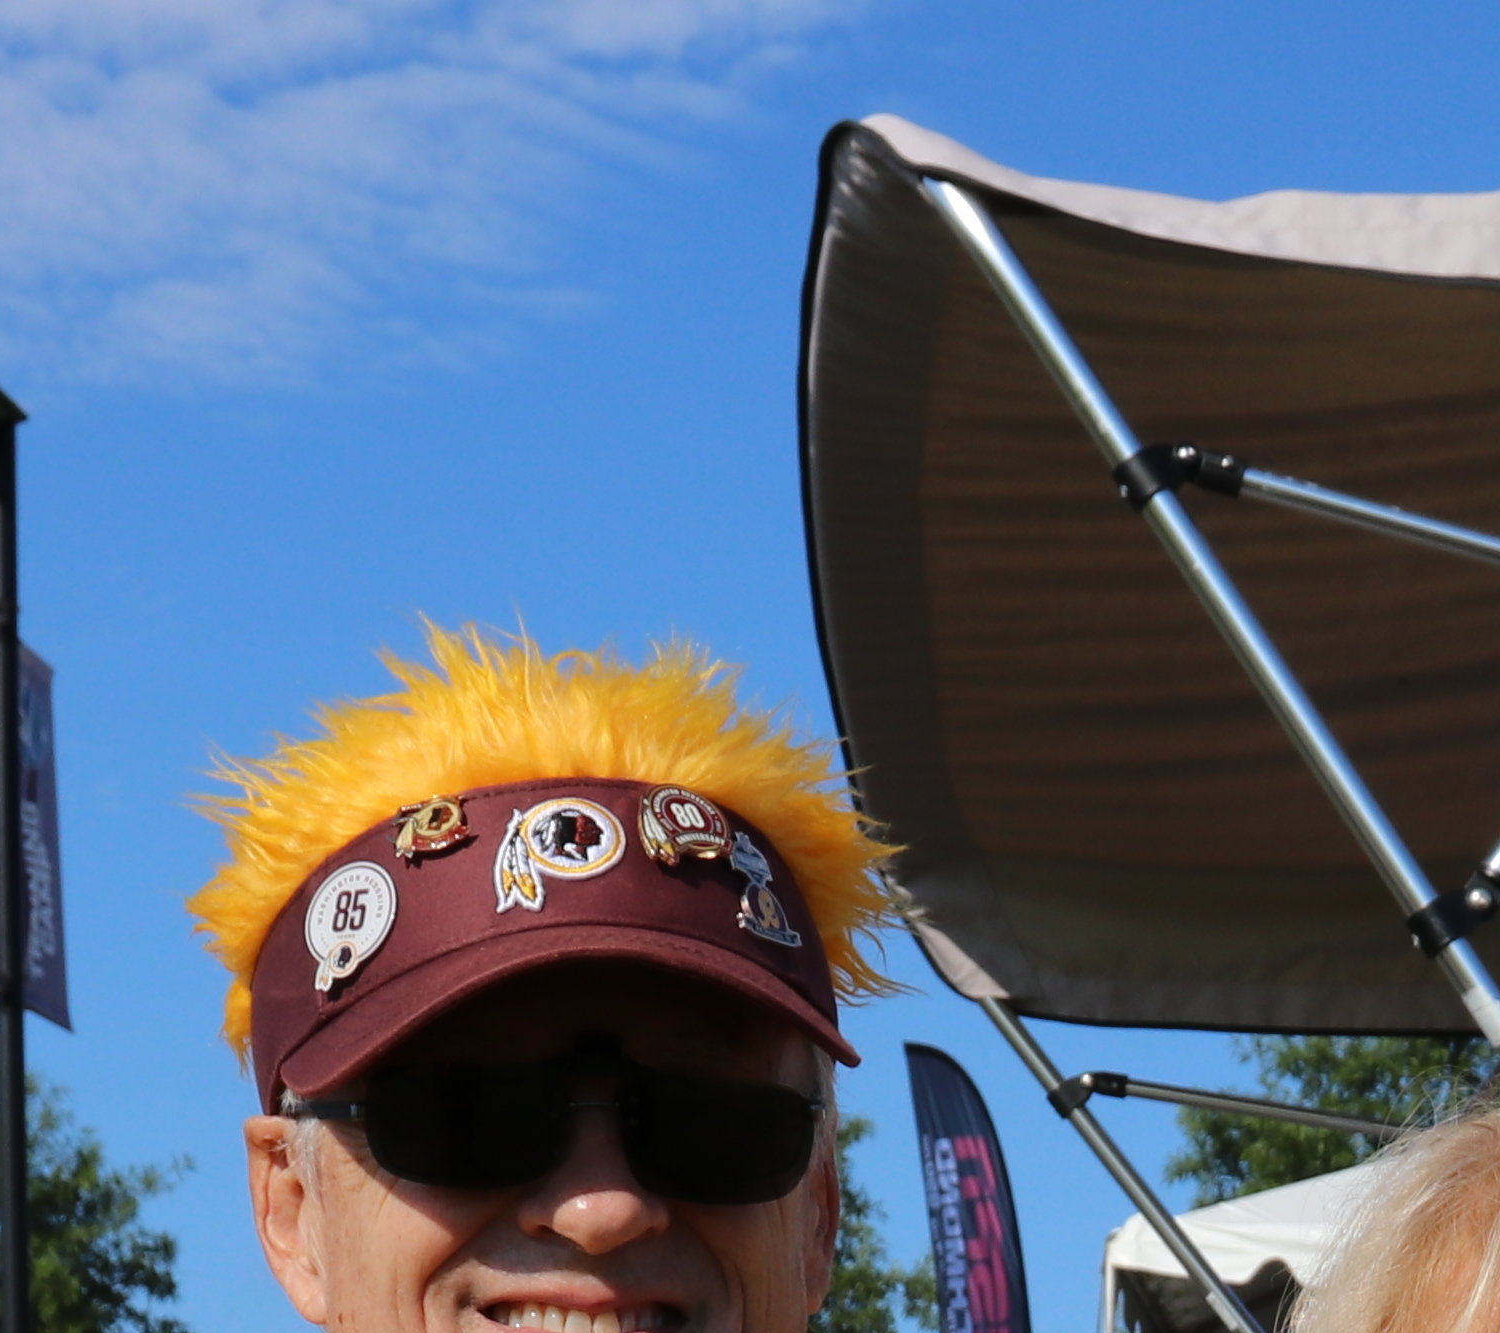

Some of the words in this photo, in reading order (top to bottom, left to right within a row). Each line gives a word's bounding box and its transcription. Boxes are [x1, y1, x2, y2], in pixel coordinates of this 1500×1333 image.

[670, 802, 706, 829] 80
[317, 874, 361, 925] WASHINGTON
[331, 888, 370, 933] 85
